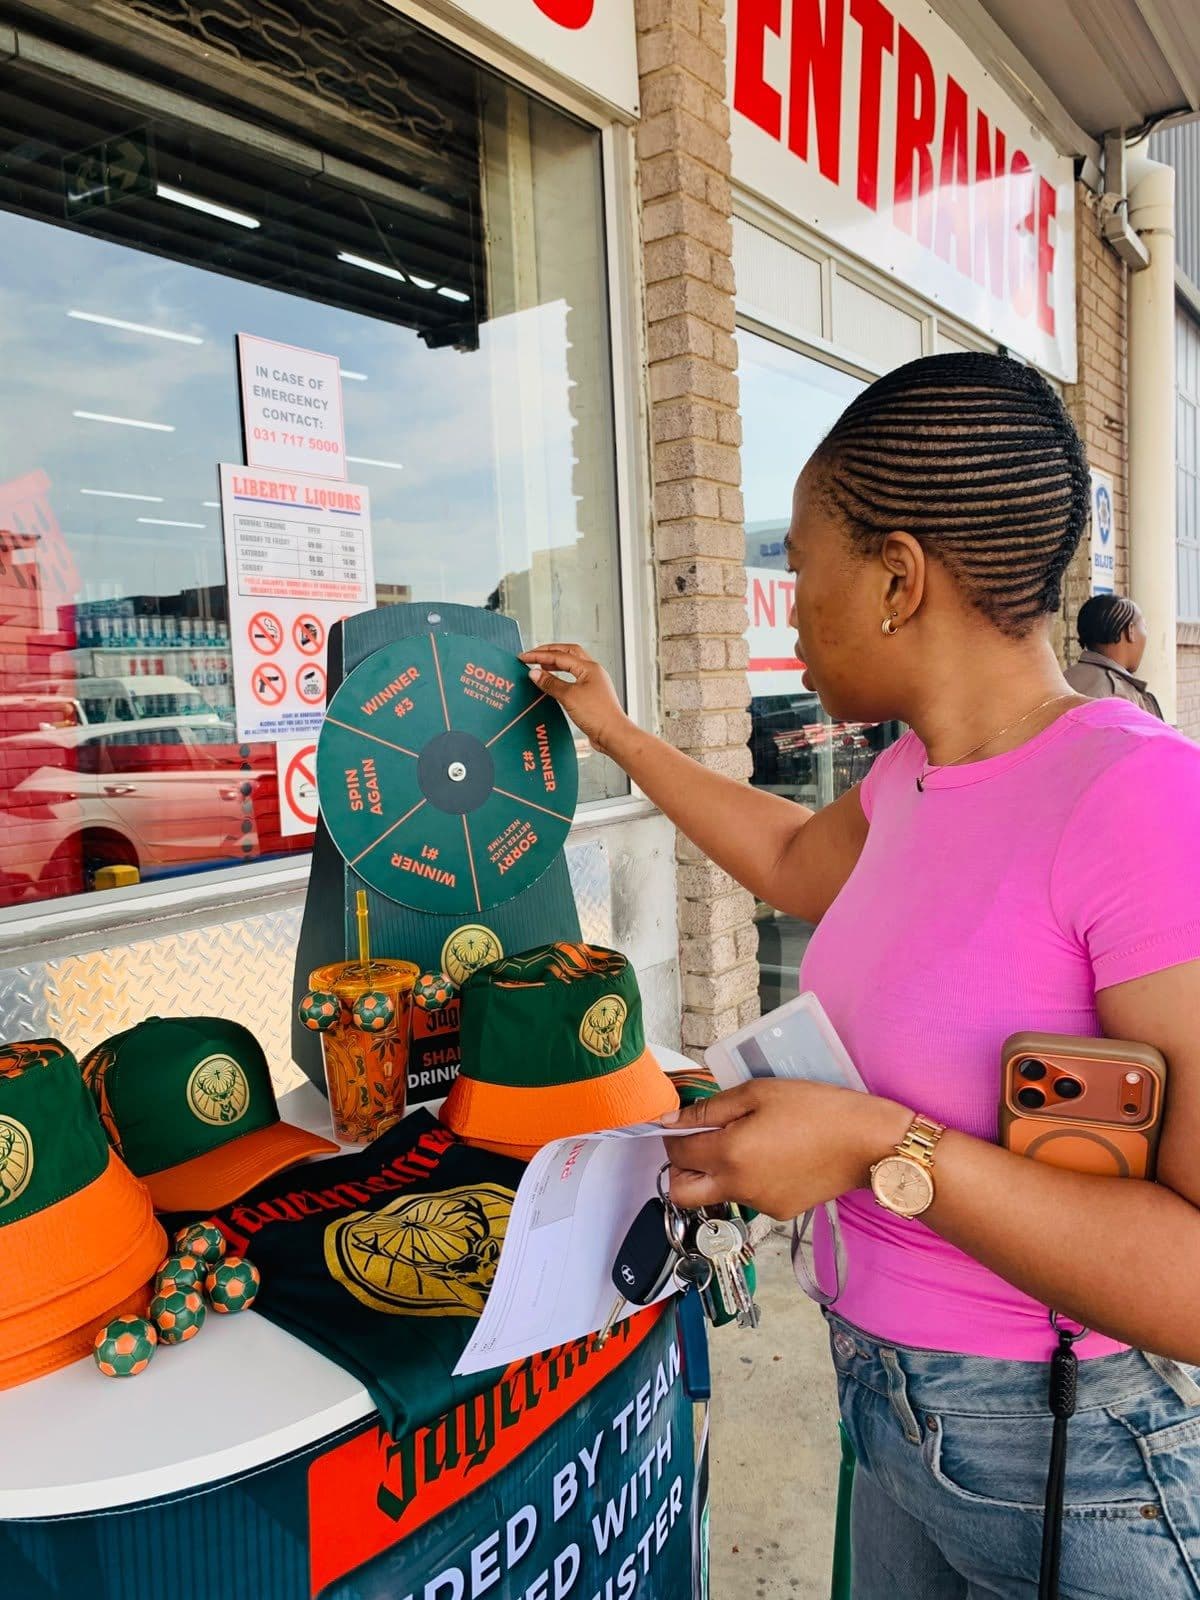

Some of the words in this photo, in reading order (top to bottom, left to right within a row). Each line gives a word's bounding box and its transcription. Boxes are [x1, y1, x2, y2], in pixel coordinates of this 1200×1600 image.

[733, 0, 1057, 338] ENTRANCE
[256, 365, 268, 378] IN
[272, 370, 305, 386] CASE
[308, 378, 324, 390] OF
[253, 385, 328, 411] EMERGENCY
[262, 408, 323, 430] CONTACT:
[254, 428, 276, 442] 031
[282, 433, 304, 448] 717
[308, 438, 338, 454] 5000
[232, 476, 296, 502] LIBERTY
[304, 487, 362, 511] LIQUORS
[460, 676, 490, 692] BETTER
[490, 690, 510, 703] LUCK
[464, 662, 514, 692] SORRY
[361, 666, 420, 716] WINNER
[464, 688, 484, 700] NEXT
[486, 697, 504, 710] TIME
[393, 697, 414, 718] #3
[522, 750, 536, 772] #2
[535, 724, 556, 792] WINNER
[345, 768, 364, 812] SPIN
[362, 758, 383, 816] AGAIN
[504, 819, 520, 838] NEXT
[508, 822, 530, 846] BETTER
[421, 844, 440, 860] #1
[488, 836, 504, 852] TIME
[490, 845, 508, 862] LUCK
[498, 832, 538, 874] SORRY
[390, 853, 457, 888] WINNER
[553, 1430, 604, 1524] BY
[592, 1420, 671, 1556] WITH
